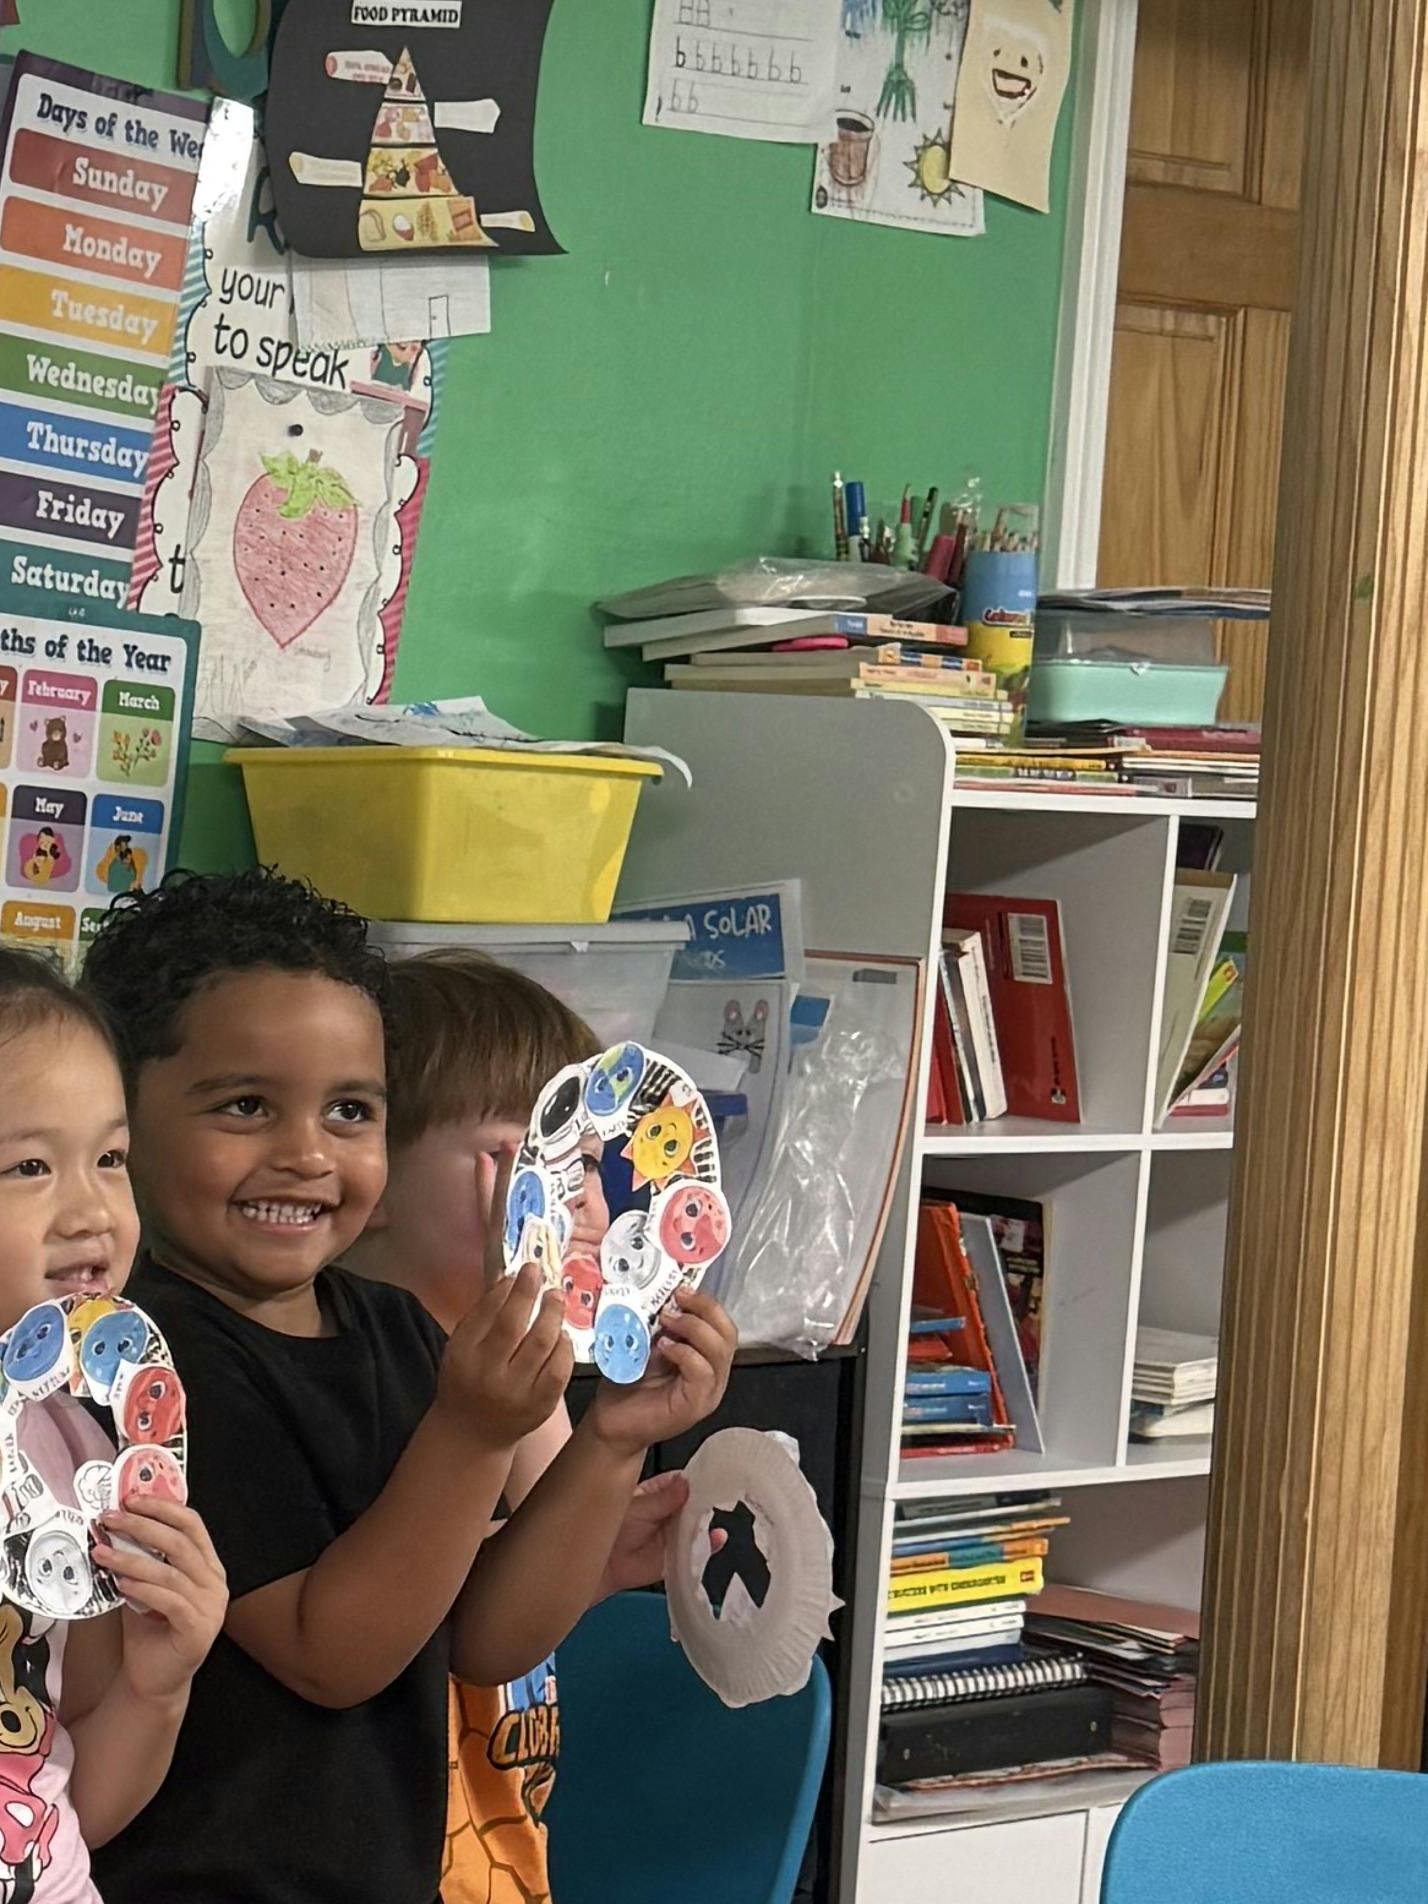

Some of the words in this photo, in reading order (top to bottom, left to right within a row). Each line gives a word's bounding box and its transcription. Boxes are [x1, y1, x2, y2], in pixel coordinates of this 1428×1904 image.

[352, 4, 388, 24] FOOD
[390, 5, 460, 26] PYRAMID
[37, 92, 88, 135] Days
[95, 111, 118, 138] of
[123, 119, 159, 151] the
[72, 157, 170, 212] Sunday
[62, 224, 163, 277] Monday
[220, 266, 287, 311] your
[50, 288, 159, 346] Tuesday
[213, 312, 249, 360] to
[255, 335, 352, 392] speak
[25, 354, 162, 416] Wednesday
[25, 419, 148, 481] Thursday
[36, 491, 126, 540] Friday
[10, 556, 131, 611] Saturday
[43, 637, 66, 661] of
[76, 639, 112, 667] the
[122, 643, 172, 675] Year
[27, 677, 93, 707] February
[118, 689, 161, 711] March
[34, 797, 65, 820] May
[111, 806, 143, 825] June
[13, 912, 63, 934] August
